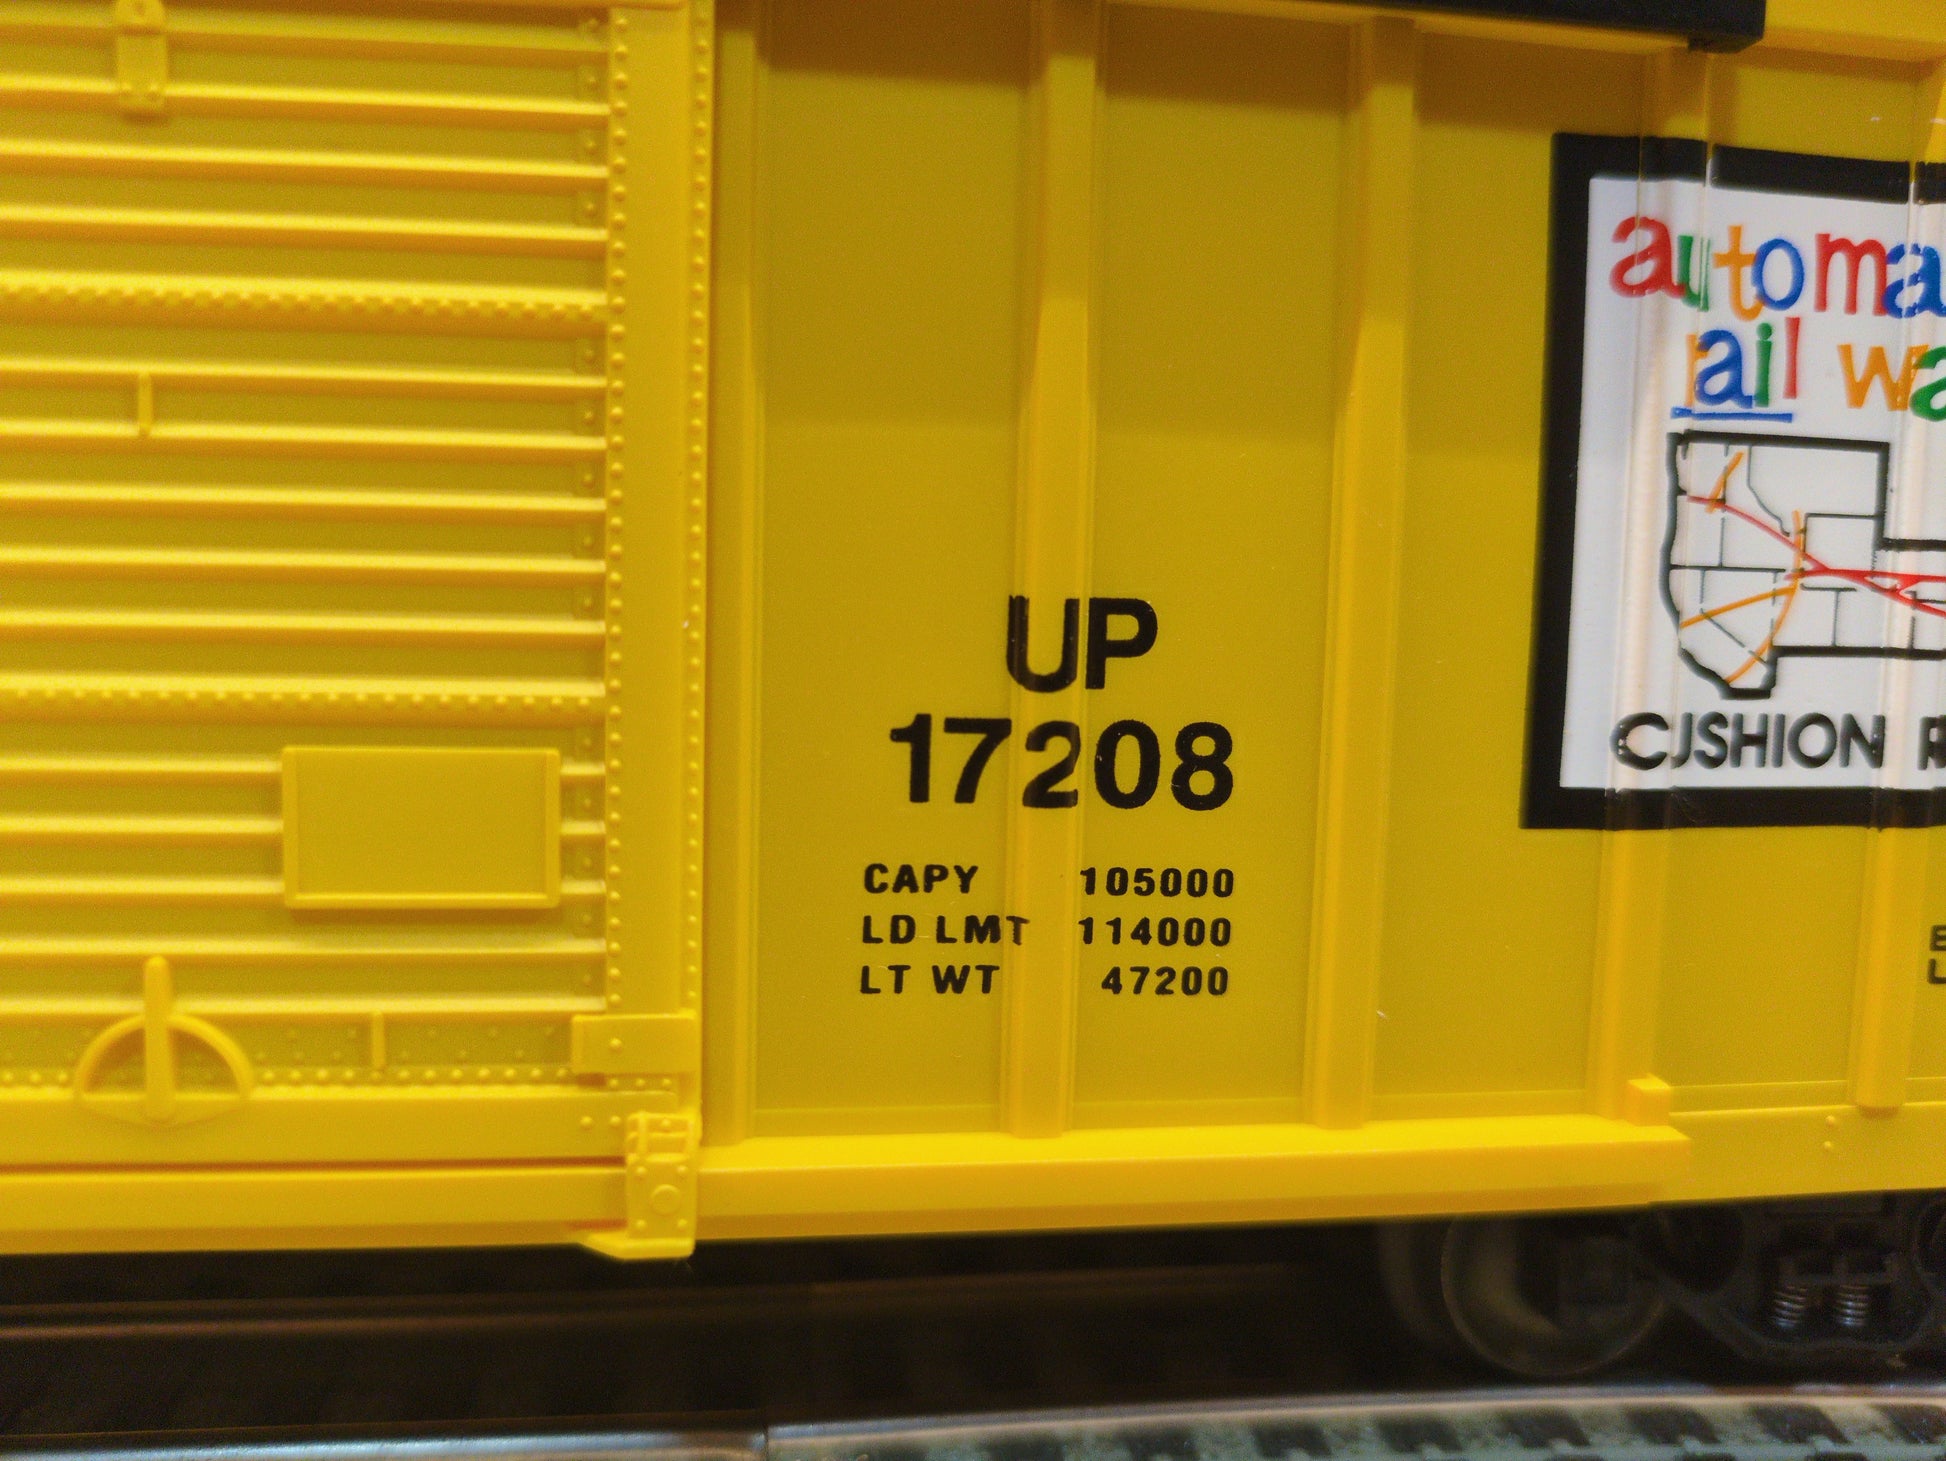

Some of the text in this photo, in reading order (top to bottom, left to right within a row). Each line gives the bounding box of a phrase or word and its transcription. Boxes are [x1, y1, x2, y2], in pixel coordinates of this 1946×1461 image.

[1684, 317, 1802, 409] rail
[1006, 595, 1158, 693] UP
[889, 713, 1234, 811] 17208
[864, 864, 1233, 897] CAPY 105000
[863, 915, 1231, 946] LD LMT 114000
[860, 965, 1228, 995] LT WT 47200
